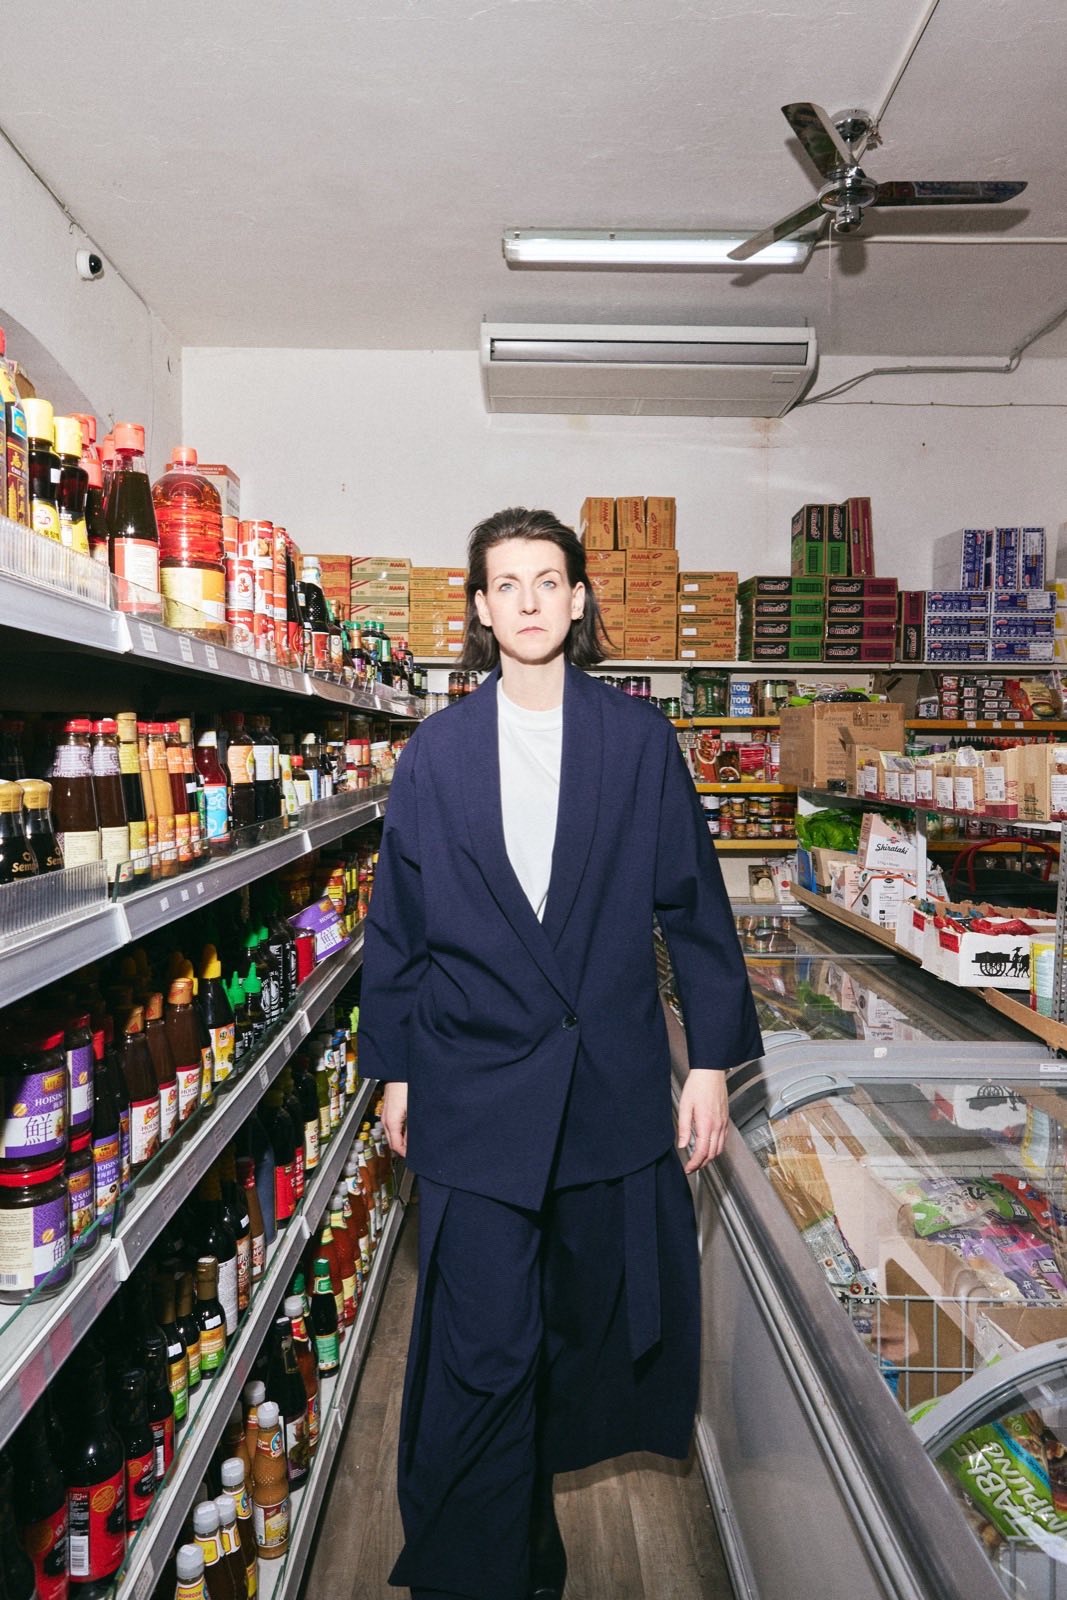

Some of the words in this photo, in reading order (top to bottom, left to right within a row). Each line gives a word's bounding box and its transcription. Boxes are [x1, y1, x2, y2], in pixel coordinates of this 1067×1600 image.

[875, 843, 910, 855] Shirataki
[35, 1093, 63, 1107] HOISIN
[24, 1113, 53, 1147] 鮮
